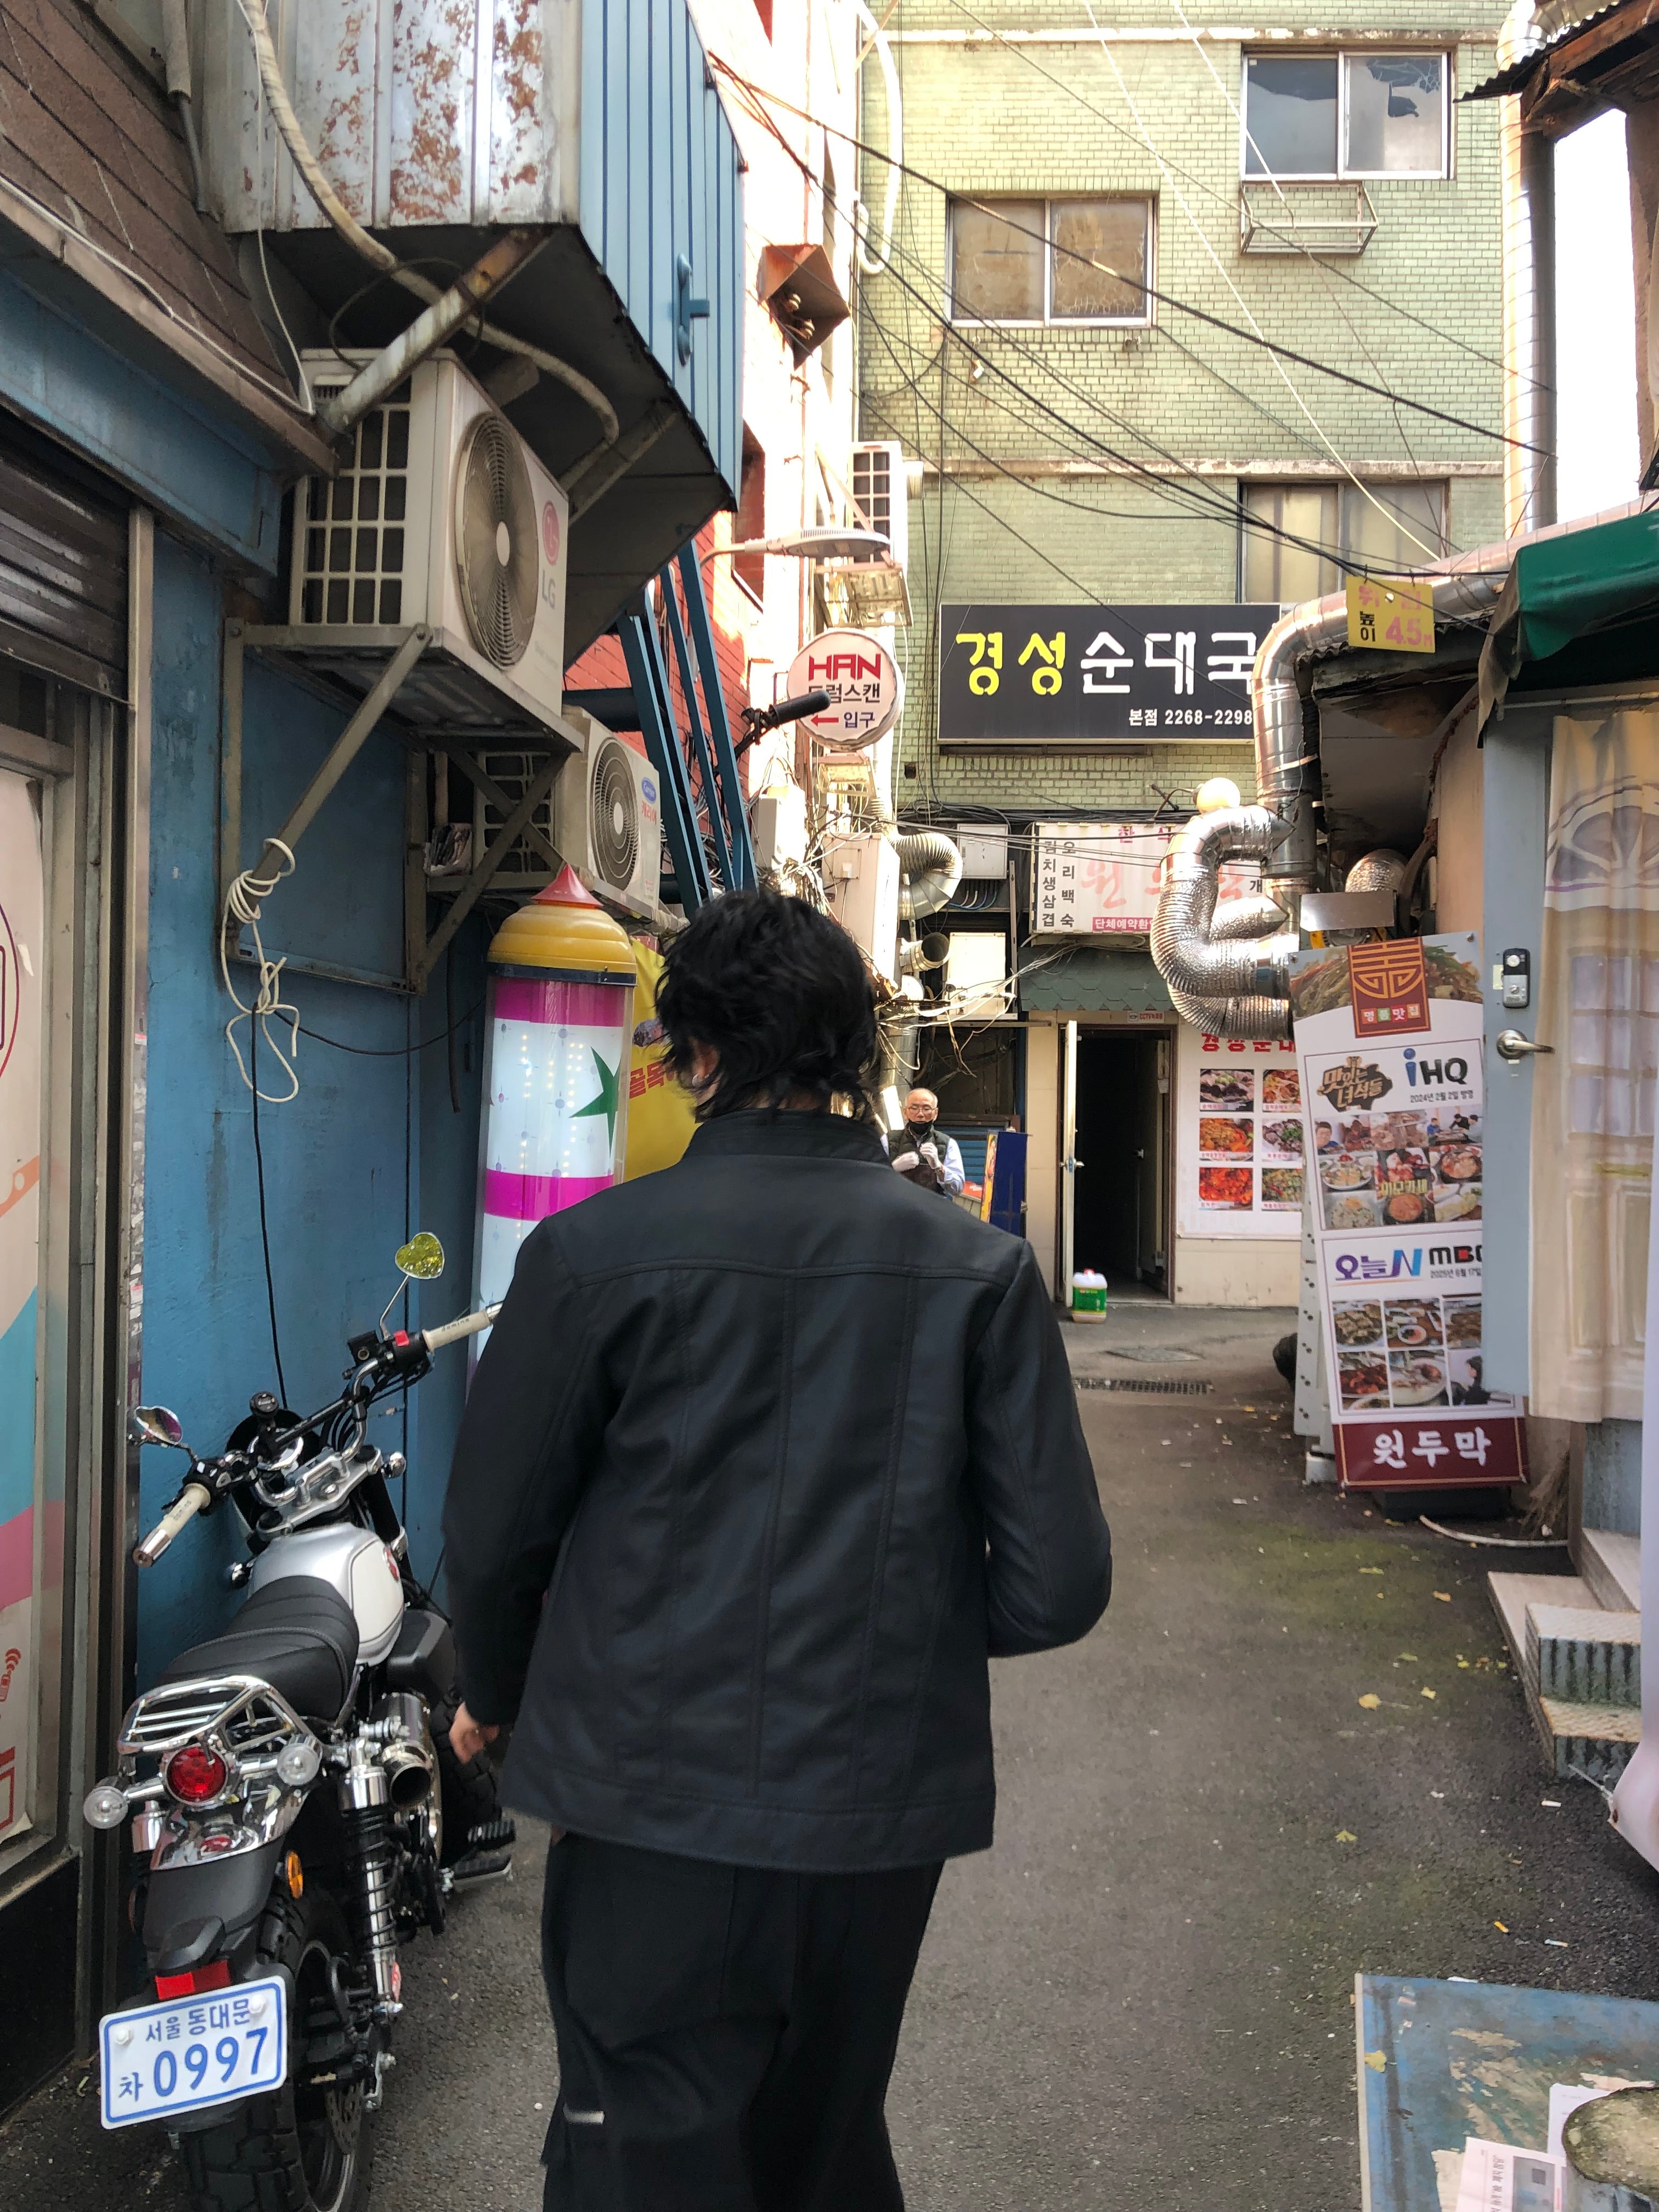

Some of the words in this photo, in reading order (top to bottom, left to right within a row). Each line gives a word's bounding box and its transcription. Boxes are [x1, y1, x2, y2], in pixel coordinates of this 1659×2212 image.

[541, 570, 556, 610] LG
[808, 653, 882, 682] HAN
[843, 711, 876, 729] 입구
[1128, 708, 1158, 726] 본점
[1165, 709, 1253, 725] 2268-2298
[1094, 918, 1153, 930] 단체예약환
[1403, 1048, 1468, 1087] iHQ
[145, 2016, 180, 2042] 서울
[188, 1999, 250, 2036] 동대문
[118, 2072, 144, 2102] 차
[153, 2027, 268, 2097] 0997
